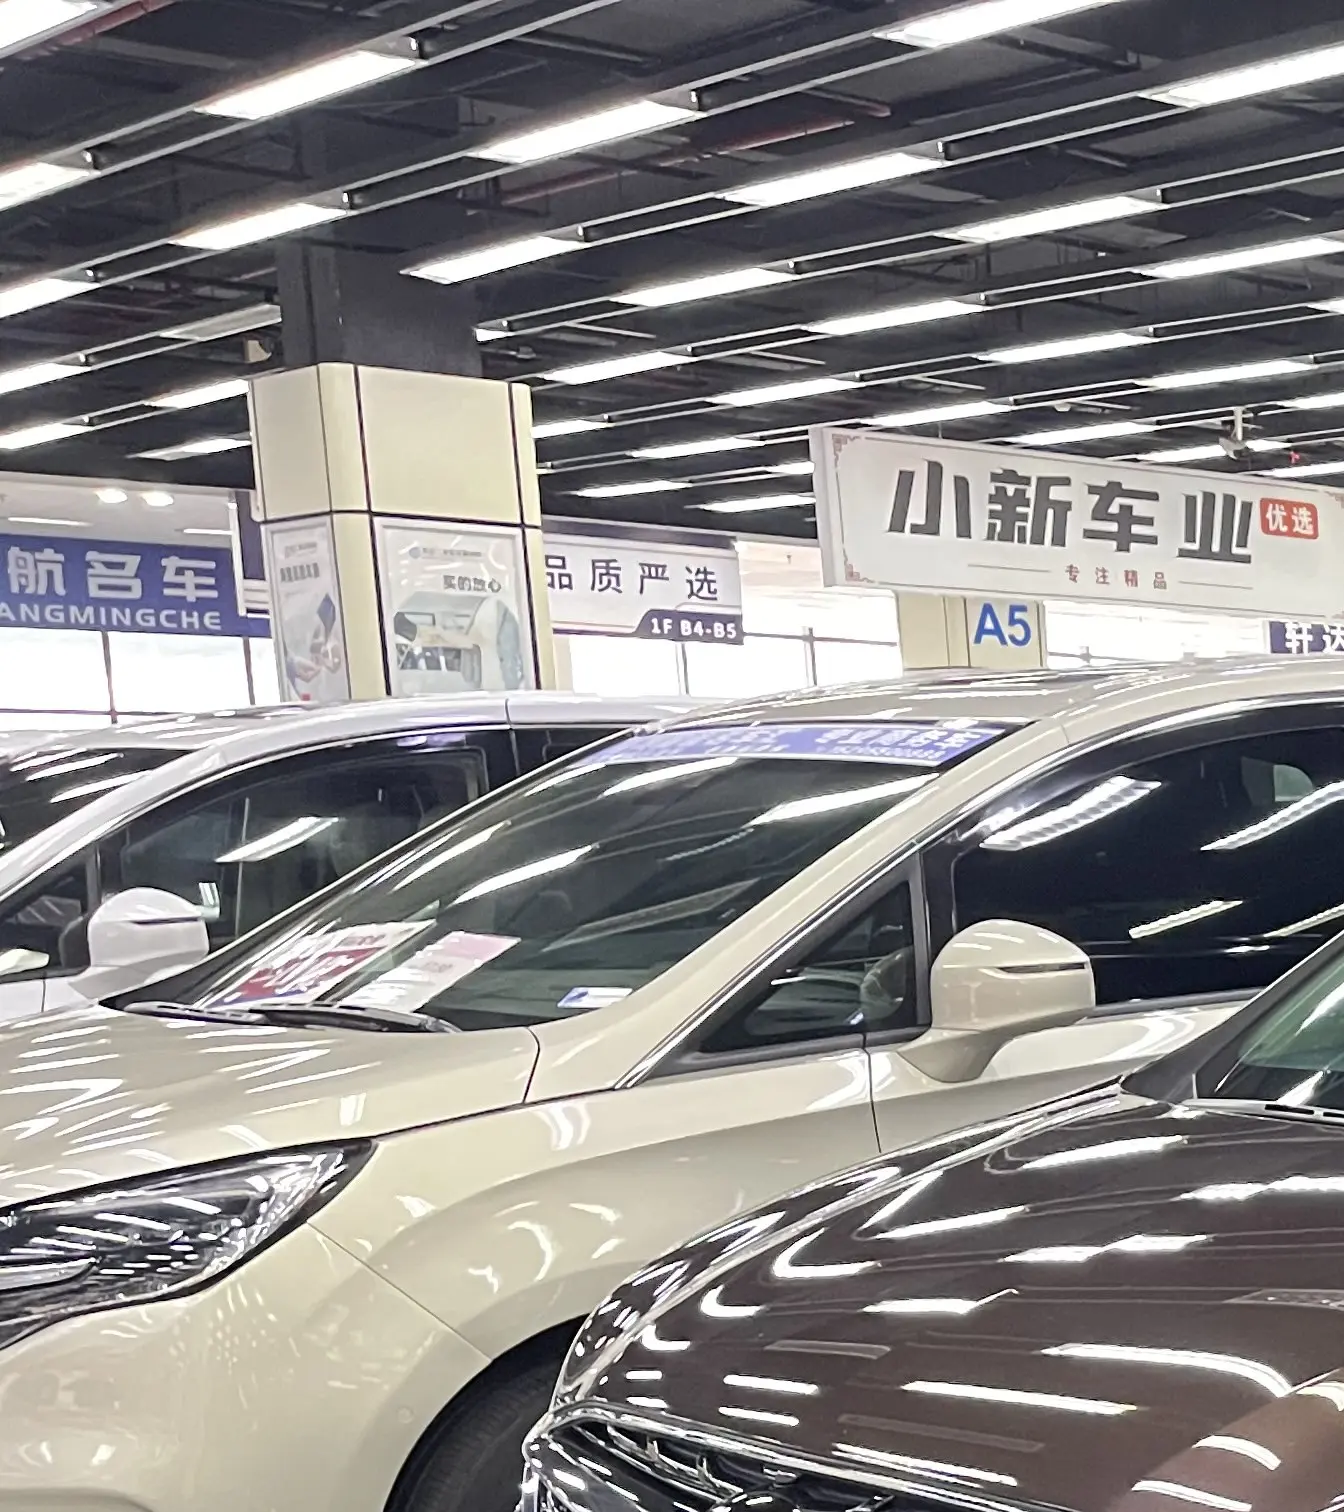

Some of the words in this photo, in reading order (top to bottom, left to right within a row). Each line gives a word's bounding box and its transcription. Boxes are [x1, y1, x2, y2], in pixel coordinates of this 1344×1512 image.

[886, 459, 1253, 564] 小新车业
[1265, 502, 1316, 536] 优选
[8, 546, 218, 603] 航名车
[545, 554, 718, 601] 品质严选
[1065, 563, 1168, 590] 专注精品
[0, 602, 222, 631] ANGMINGCHE
[651, 617, 674, 634] 1F
[680, 619, 737, 639] B4-B5
[973, 602, 1032, 647] A5
